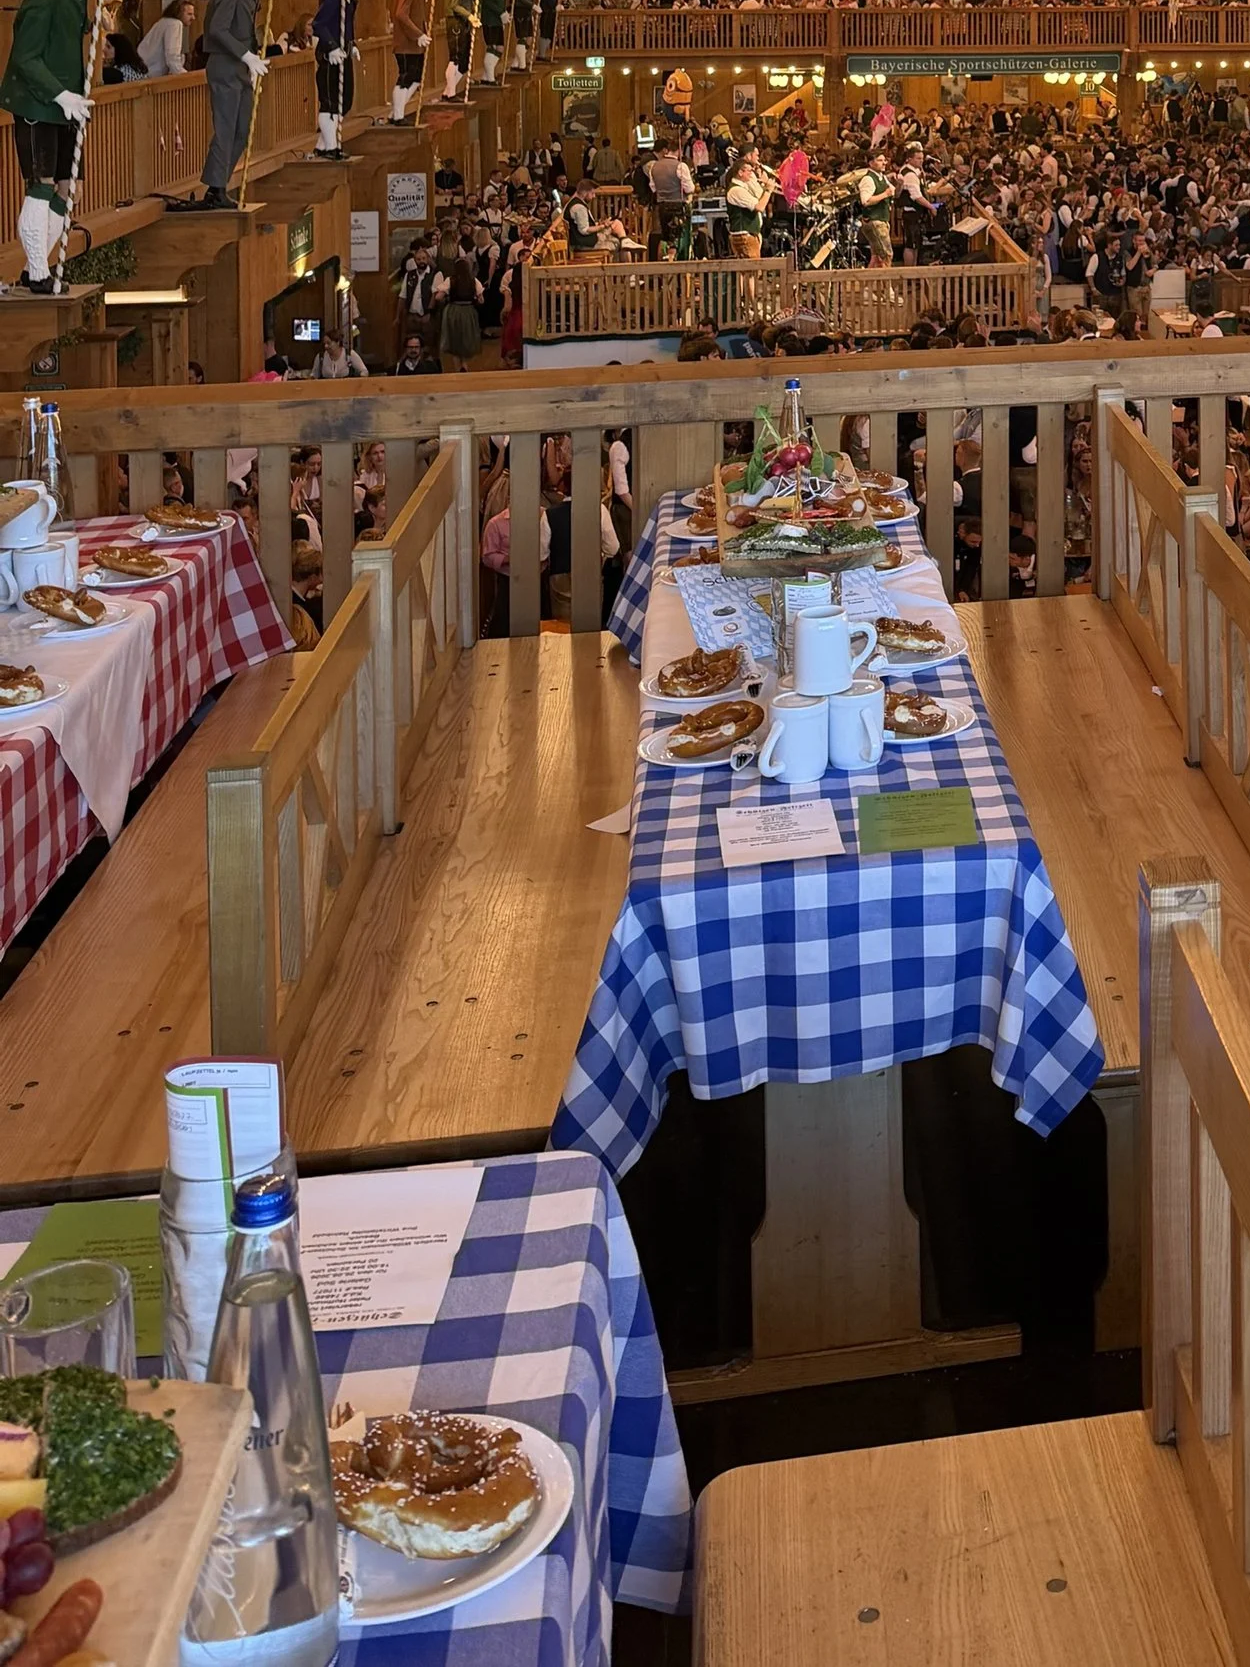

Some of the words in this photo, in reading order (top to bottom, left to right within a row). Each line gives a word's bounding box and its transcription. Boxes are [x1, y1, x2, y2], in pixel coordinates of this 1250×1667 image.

[871, 59, 945, 73] Bayerische
[950, 58, 1098, 72] Sportschützen-Galerie
[557, 77, 599, 87] Toiletten
[1085, 81, 1095, 91] 10
[388, 194, 425, 202] Qualität
